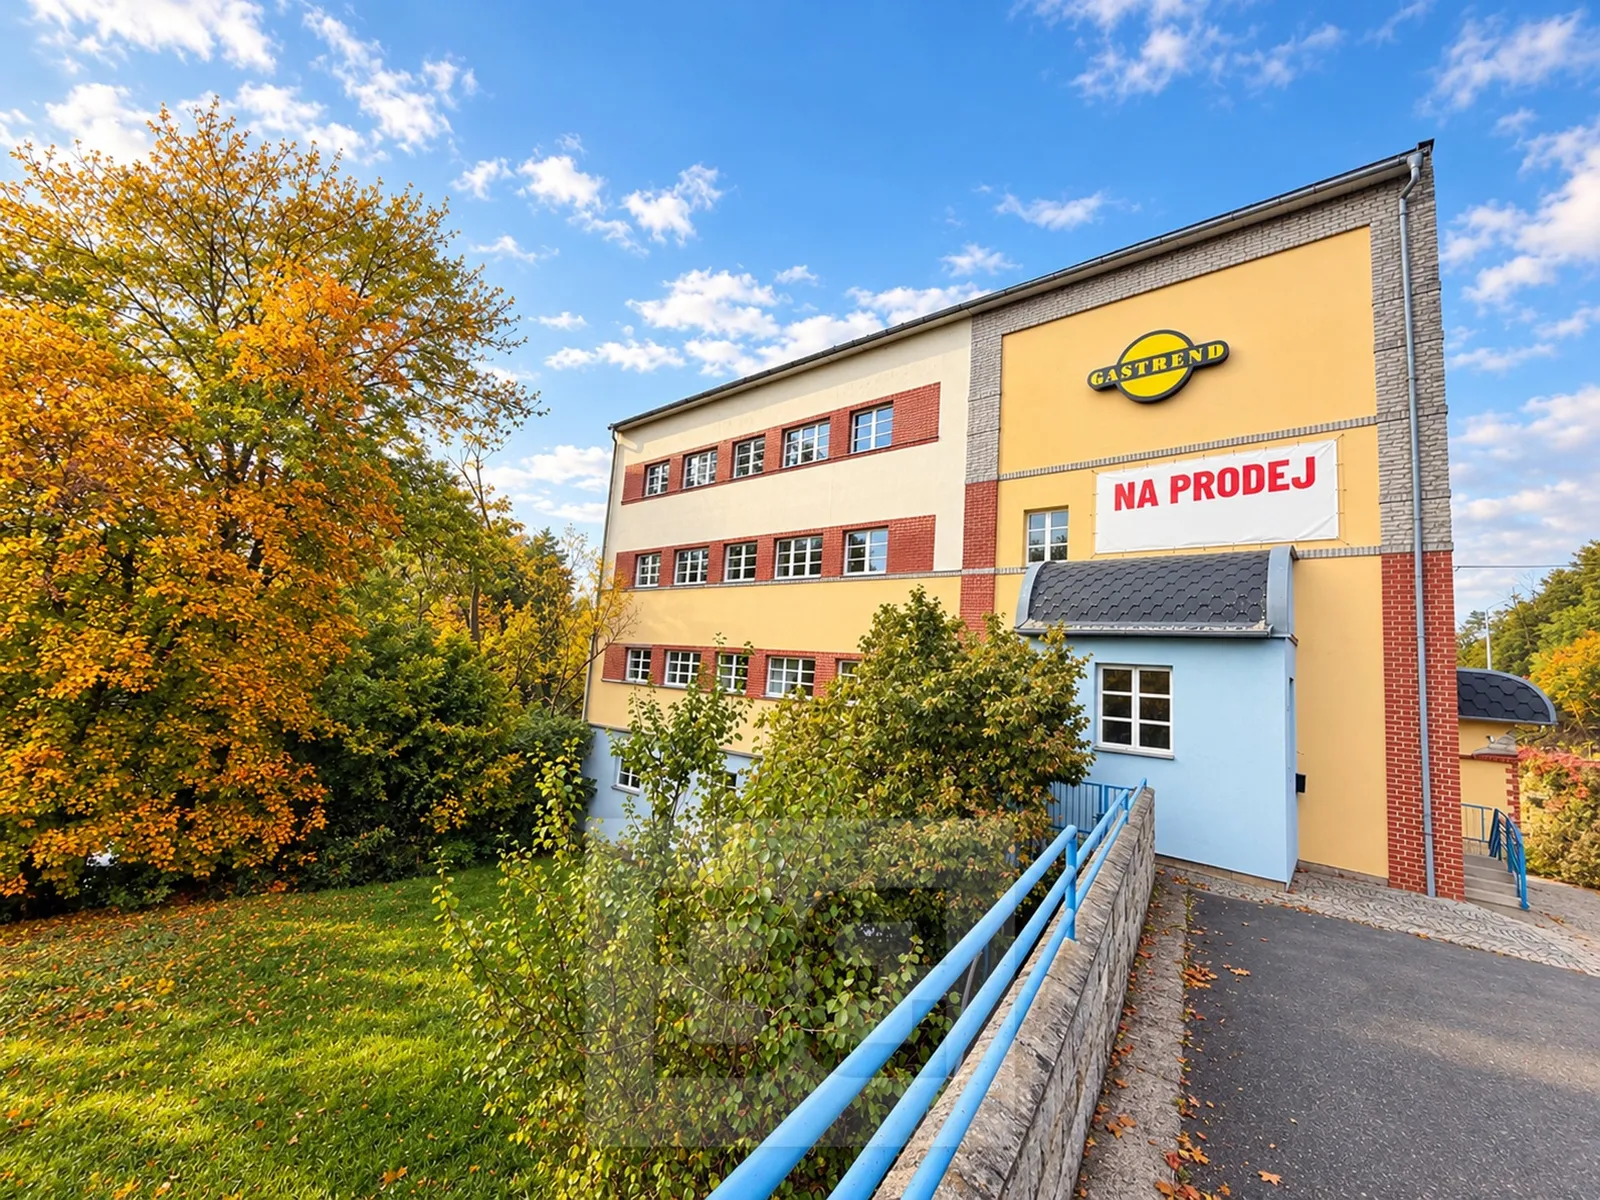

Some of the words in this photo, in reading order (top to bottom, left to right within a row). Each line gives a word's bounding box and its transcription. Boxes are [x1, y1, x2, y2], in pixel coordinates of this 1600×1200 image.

[1090, 343, 1225, 386] GASTREND
[1114, 479, 1159, 511] NA
[1169, 455, 1316, 504] PRODEJ
